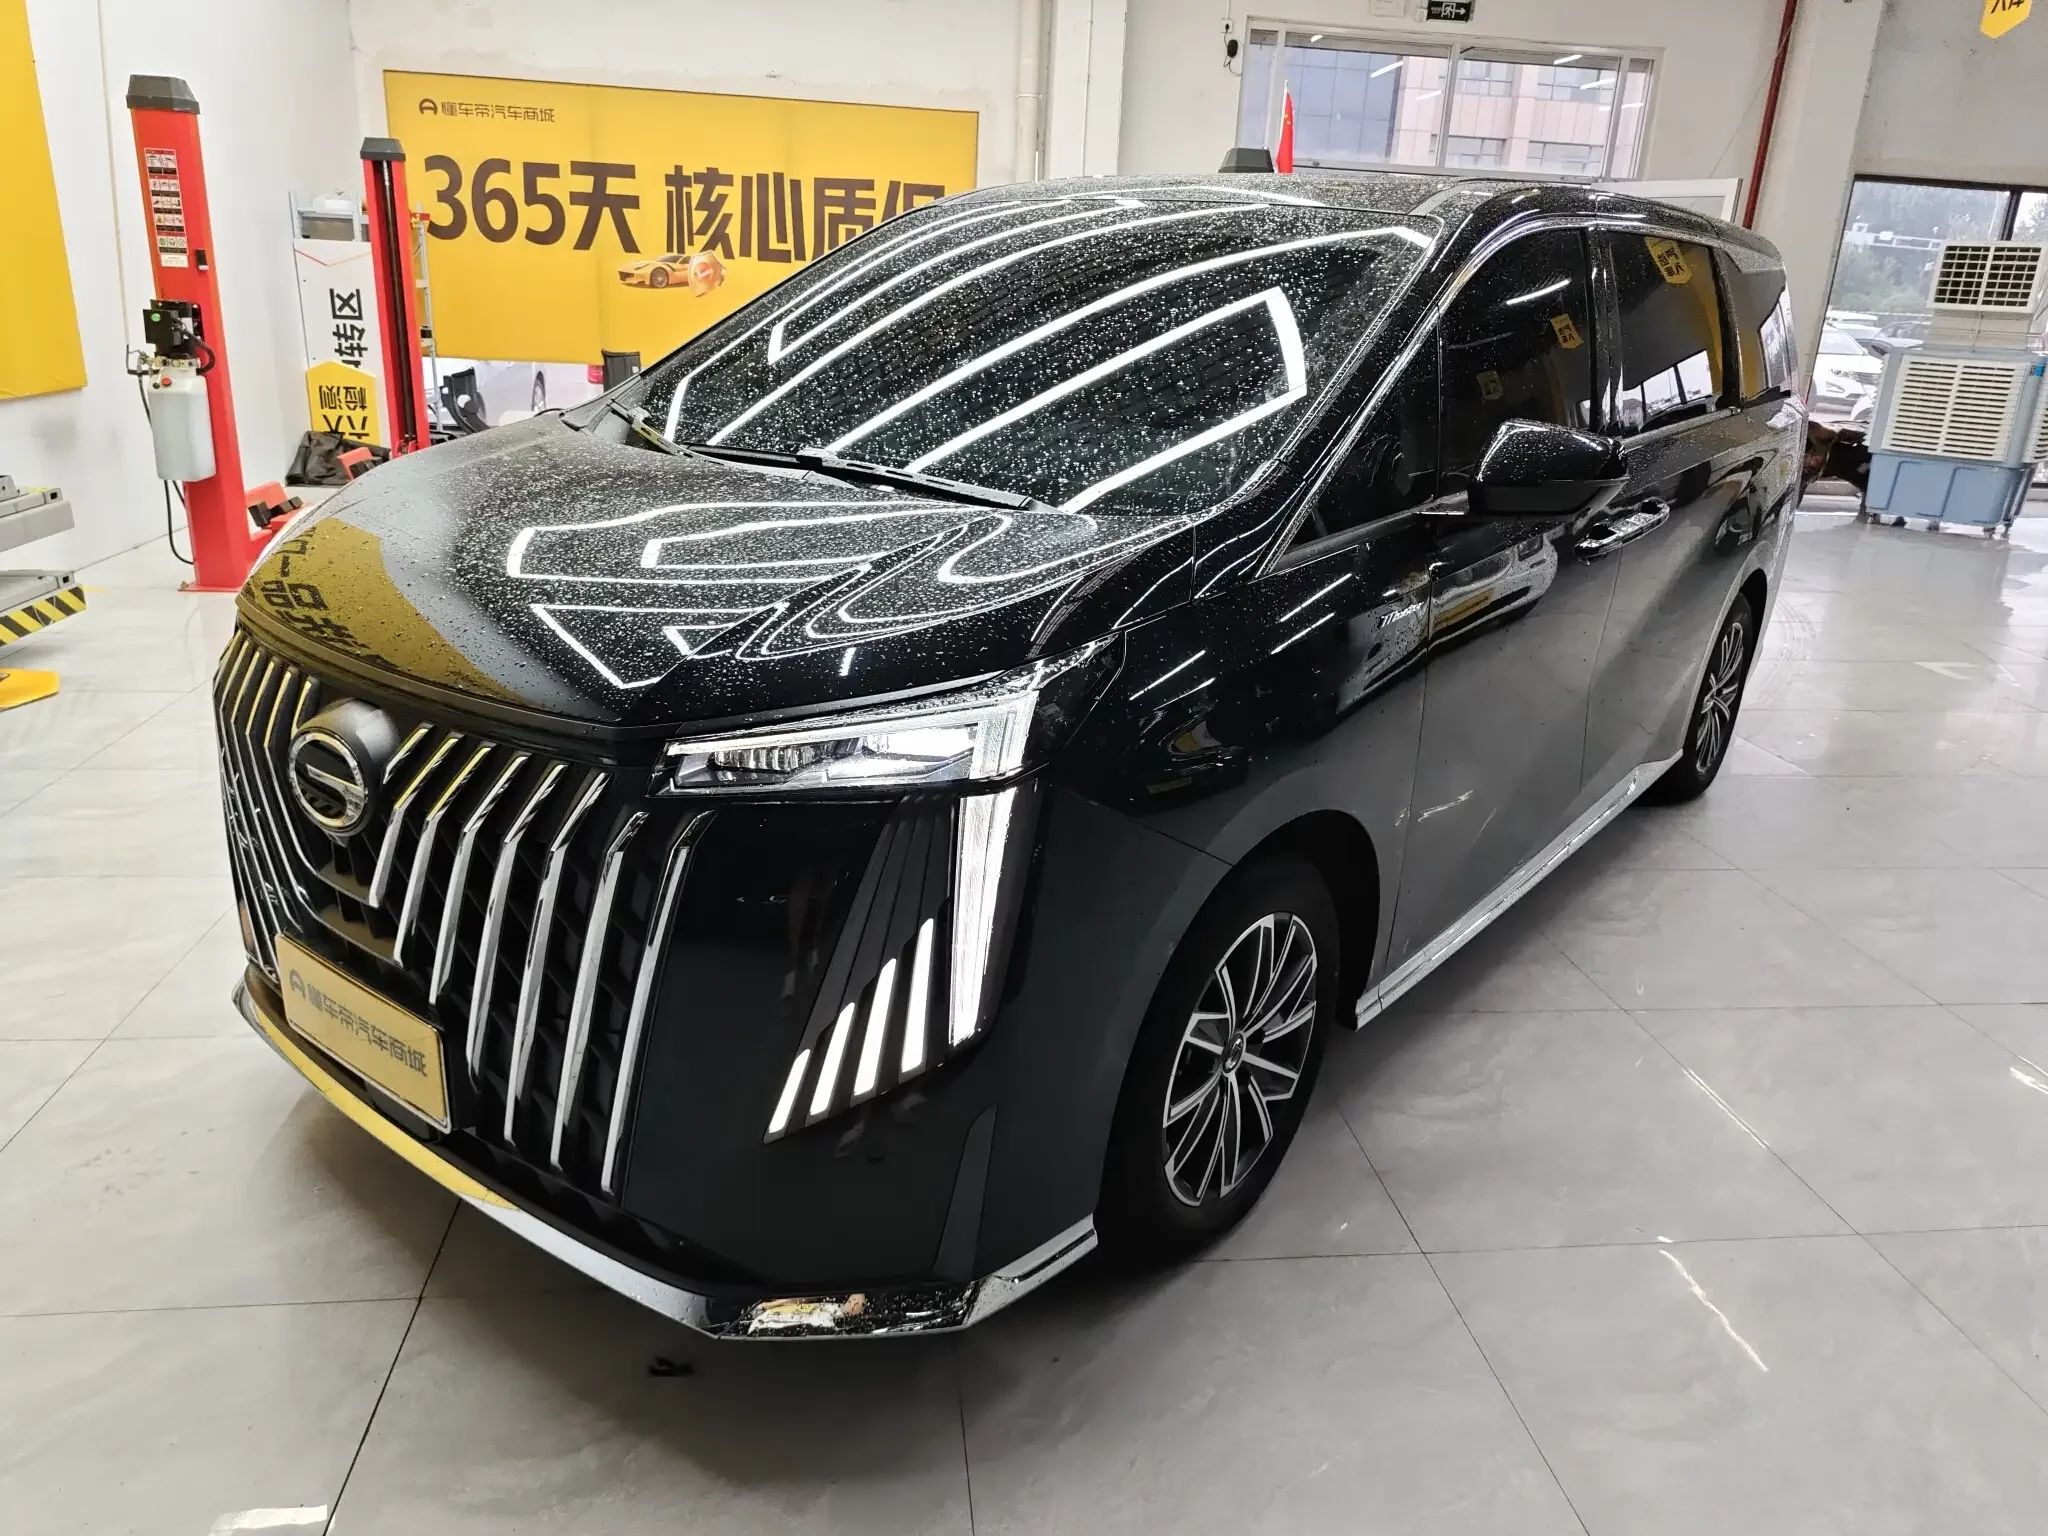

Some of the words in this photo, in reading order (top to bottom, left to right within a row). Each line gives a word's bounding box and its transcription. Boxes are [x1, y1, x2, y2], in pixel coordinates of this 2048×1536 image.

[441, 101, 556, 123] 懂车帝汽车商城
[424, 154, 641, 255] 365天
[329, 288, 369, 369] 转区
[307, 983, 428, 1077] 懂车帝汽车商城
